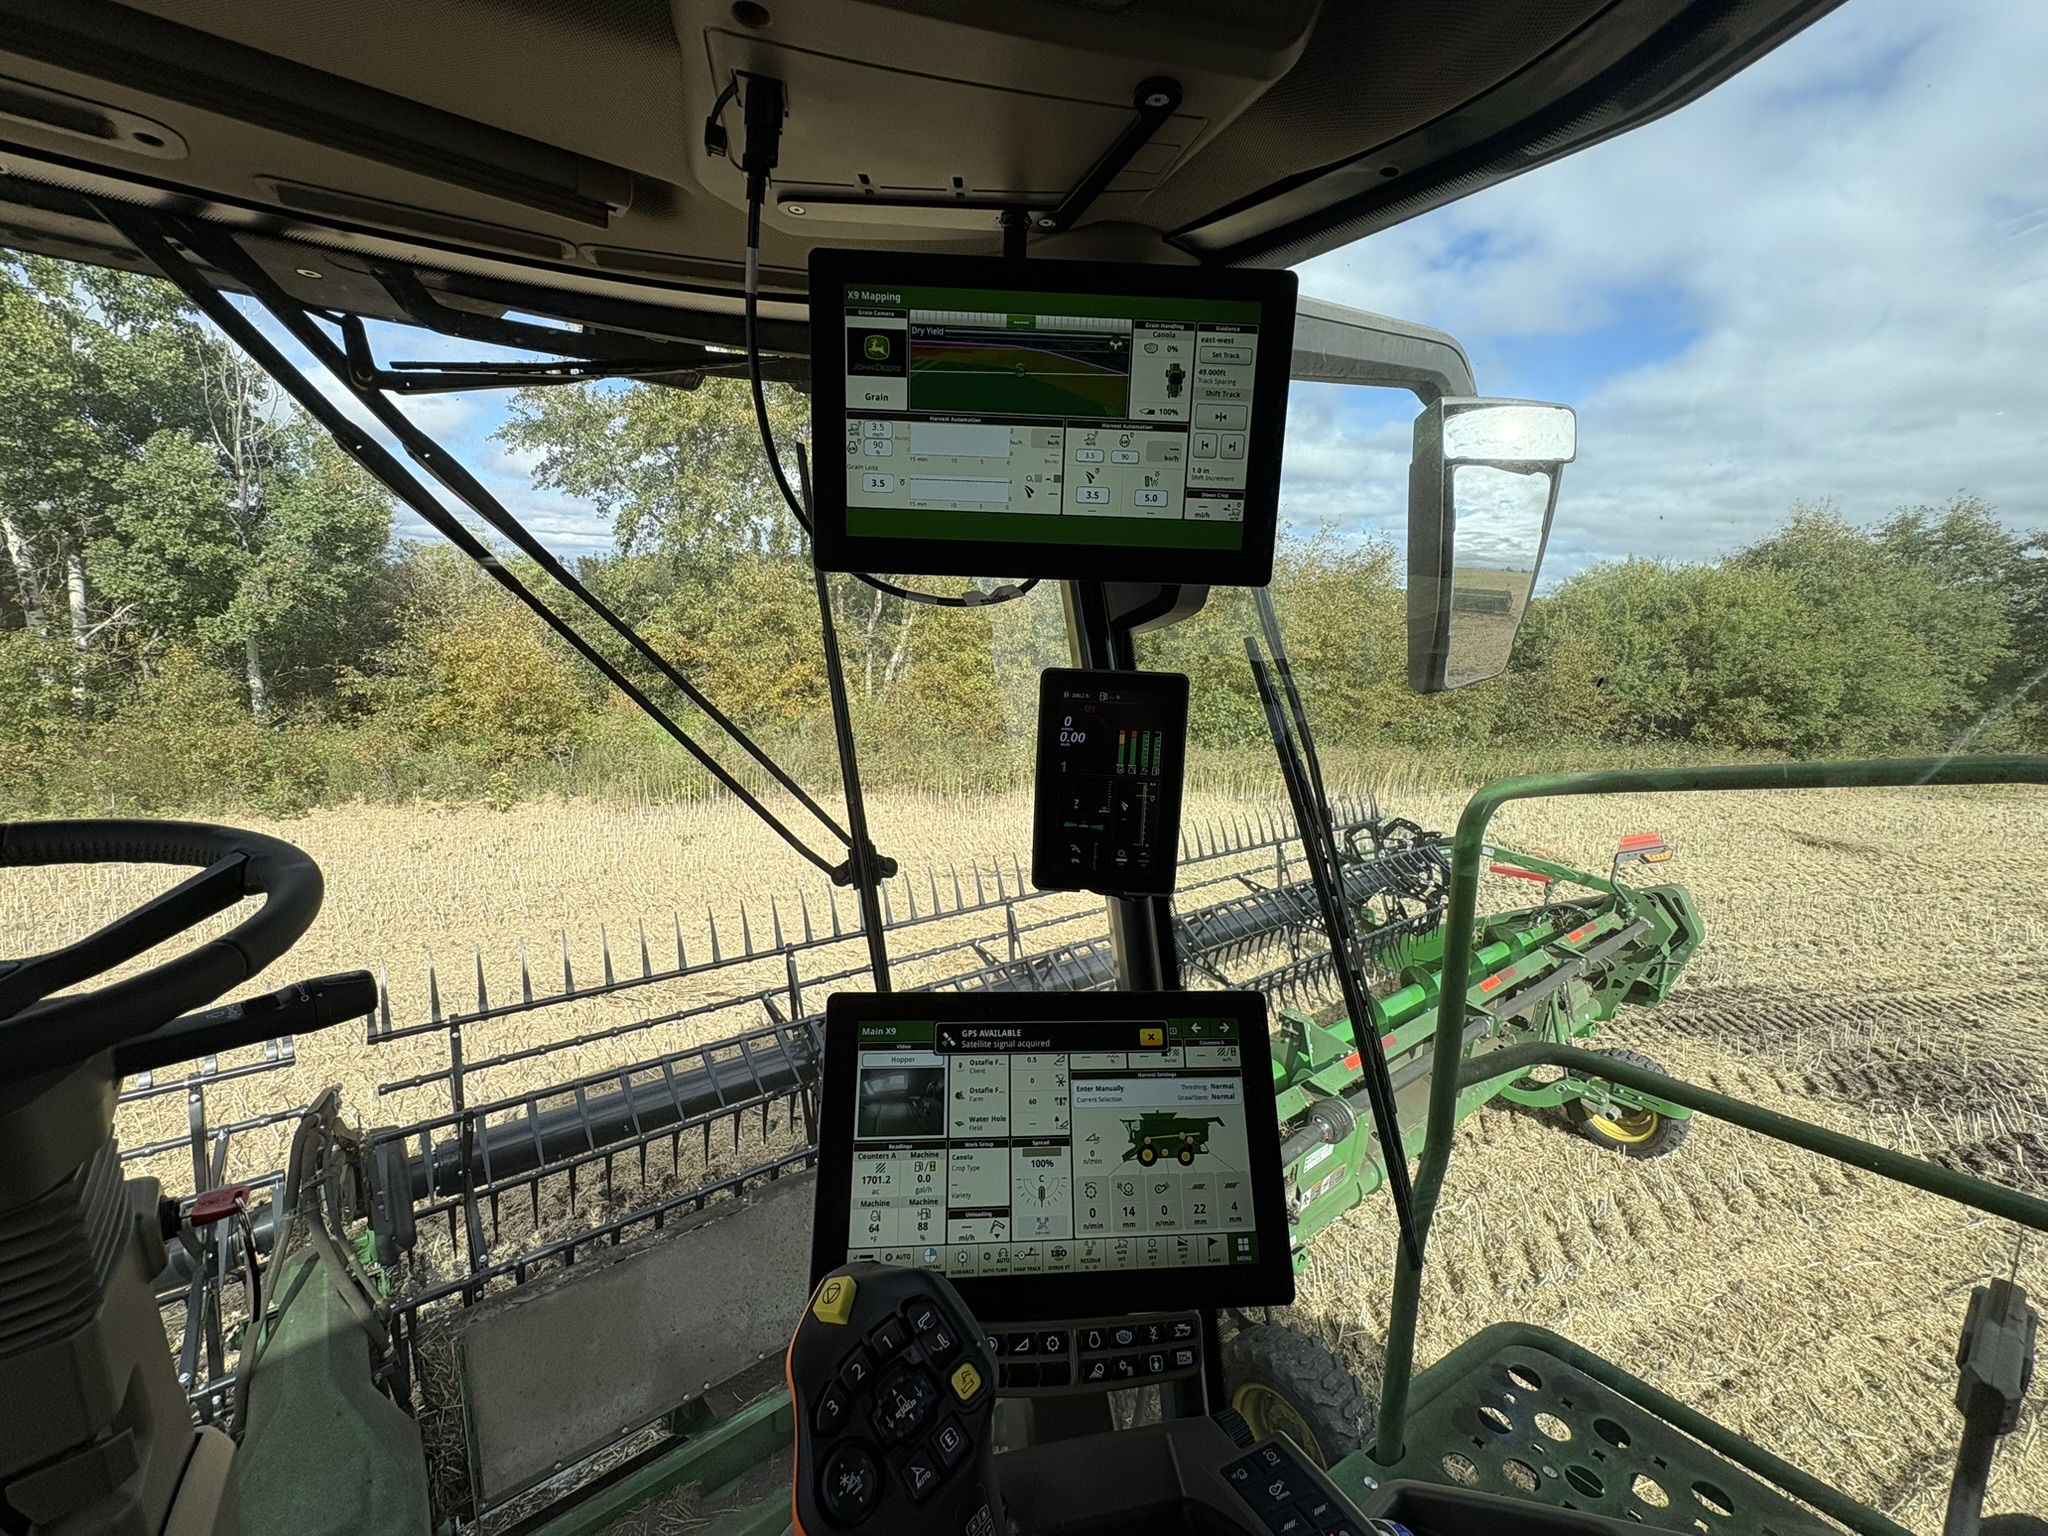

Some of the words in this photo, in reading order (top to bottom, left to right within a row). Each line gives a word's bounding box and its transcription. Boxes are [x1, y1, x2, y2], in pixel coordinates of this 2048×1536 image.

[848, 291, 859, 300] X9
[861, 291, 901, 303] Mapping
[912, 327, 925, 336] Dry
[926, 327, 944, 335] Yield
[852, 363, 875, 371] JOHN
[875, 364, 902, 372] DEERE
[865, 393, 889, 401] Grain
[871, 423, 884, 431] 3.5
[872, 441, 883, 449] 90
[871, 479, 885, 488] 3.5
[1086, 491, 1099, 500] 3.5
[1144, 494, 1158, 502] 5.0
[1064, 716, 1072, 727] 0
[1060, 731, 1086, 743] 0.00
[1060, 761, 1066, 772] 1
[862, 1027, 883, 1036] Main
[979, 1029, 1021, 1037] AVAILABLE
[961, 1040, 992, 1048] Satellite
[994, 1040, 1016, 1049] signal
[1018, 1039, 1050, 1049] acquired
[891, 1056, 915, 1065] Hopper
[1095, 1084, 1124, 1093] Manually
[1031, 1159, 1054, 1168] 100%
[862, 1175, 891, 1185] 1701.2
[917, 1174, 931, 1183] 0.0
[1038, 1174, 1044, 1183] C
[915, 1186, 932, 1195] gal/h
[1161, 1205, 1168, 1215] 0
[1193, 1204, 1206, 1214] 22
[1231, 1201, 1238, 1211] 4
[1089, 1208, 1096, 1218] 0
[1123, 1206, 1135, 1217] 14
[868, 1224, 879, 1233] 64
[918, 1222, 928, 1231] 88
[882, 1336, 893, 1348] 1
[852, 1363, 866, 1380] 2
[827, 1400, 839, 1416] 3
[944, 1433, 954, 1445] E
